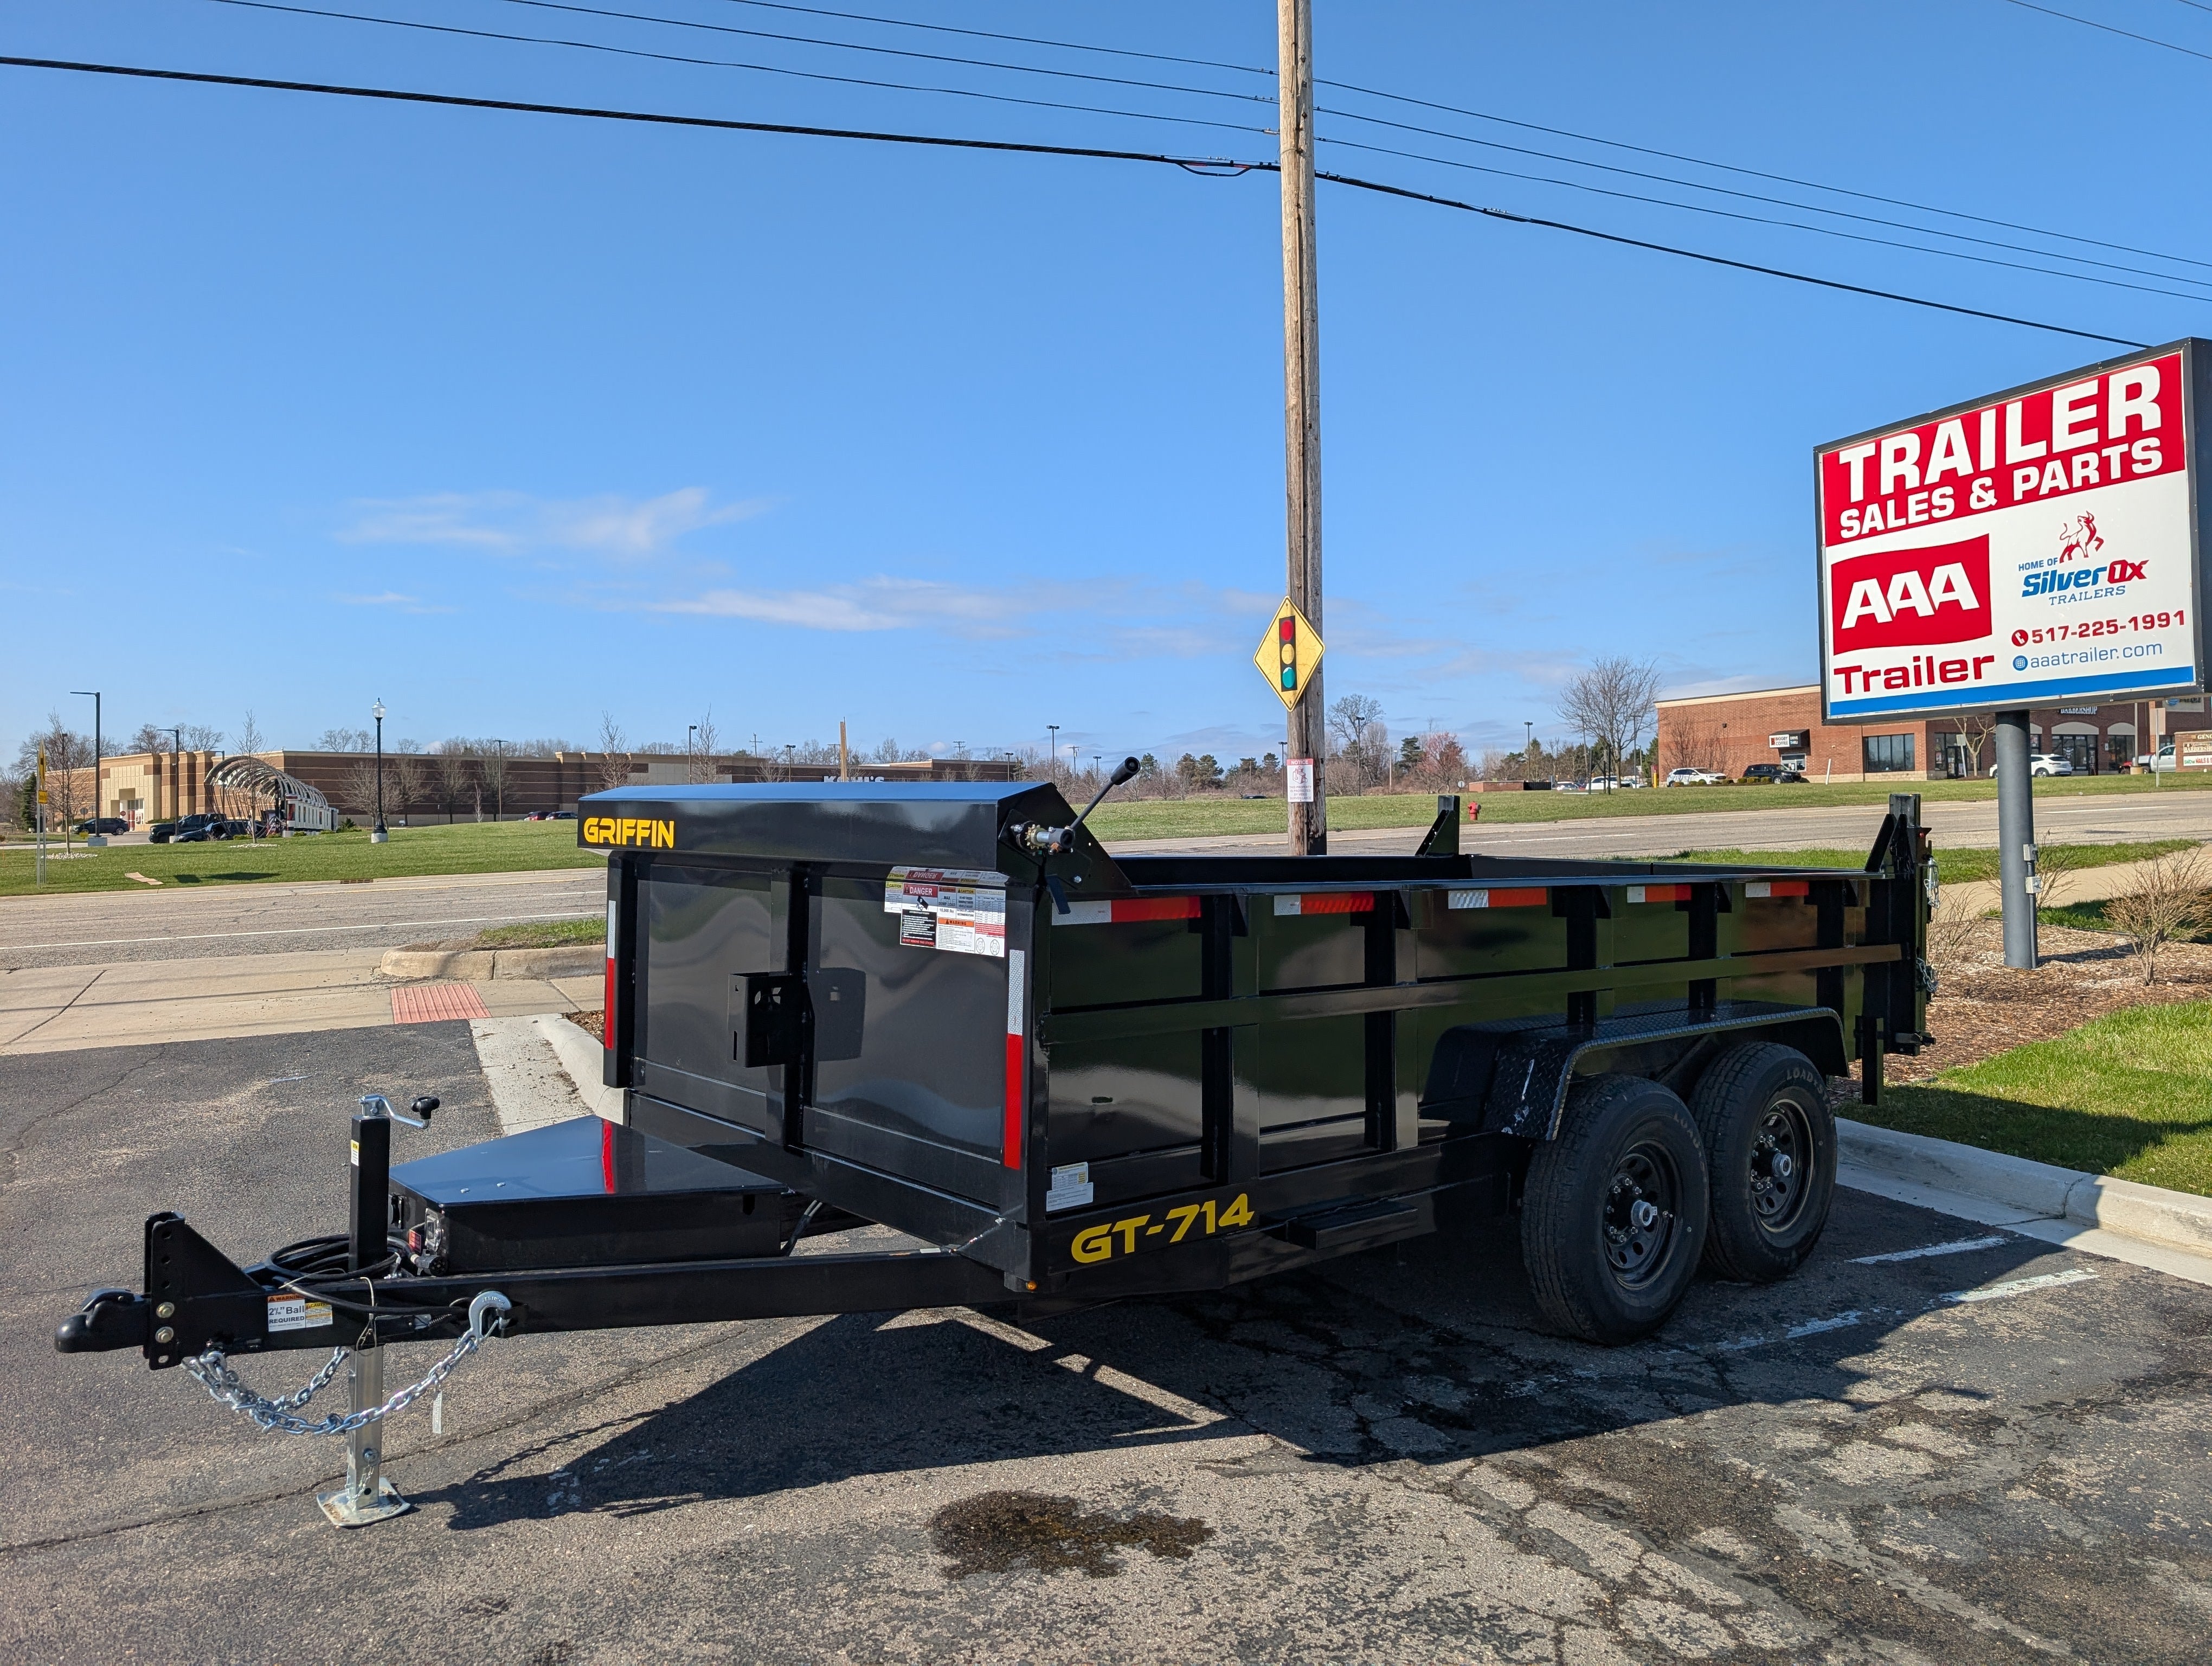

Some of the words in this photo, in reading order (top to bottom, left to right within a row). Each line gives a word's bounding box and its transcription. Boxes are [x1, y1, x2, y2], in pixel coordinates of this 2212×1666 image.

[1839, 365, 2162, 503] TRAILER
[1840, 486, 1954, 539] SALES
[1970, 477, 1998, 510] &
[2013, 436, 2163, 501] PARTS
[2018, 560, 2044, 571] HOME
[2047, 558, 2058, 566] OF
[1841, 562, 1980, 630] AAA
[2049, 585, 2126, 606] TRAILERS
[2032, 610, 2185, 644] 517-225-1991
[2030, 643, 2163, 668] aaatrailer.com
[1834, 655, 1995, 695] Trailer
[583, 817, 674, 849] GRIFFIN
[909, 886, 933, 896] DANGER
[1071, 1193, 1255, 1264] GT-714
[268, 1316, 305, 1324] REQUIRED
[286, 1305, 305, 1314] Ball
